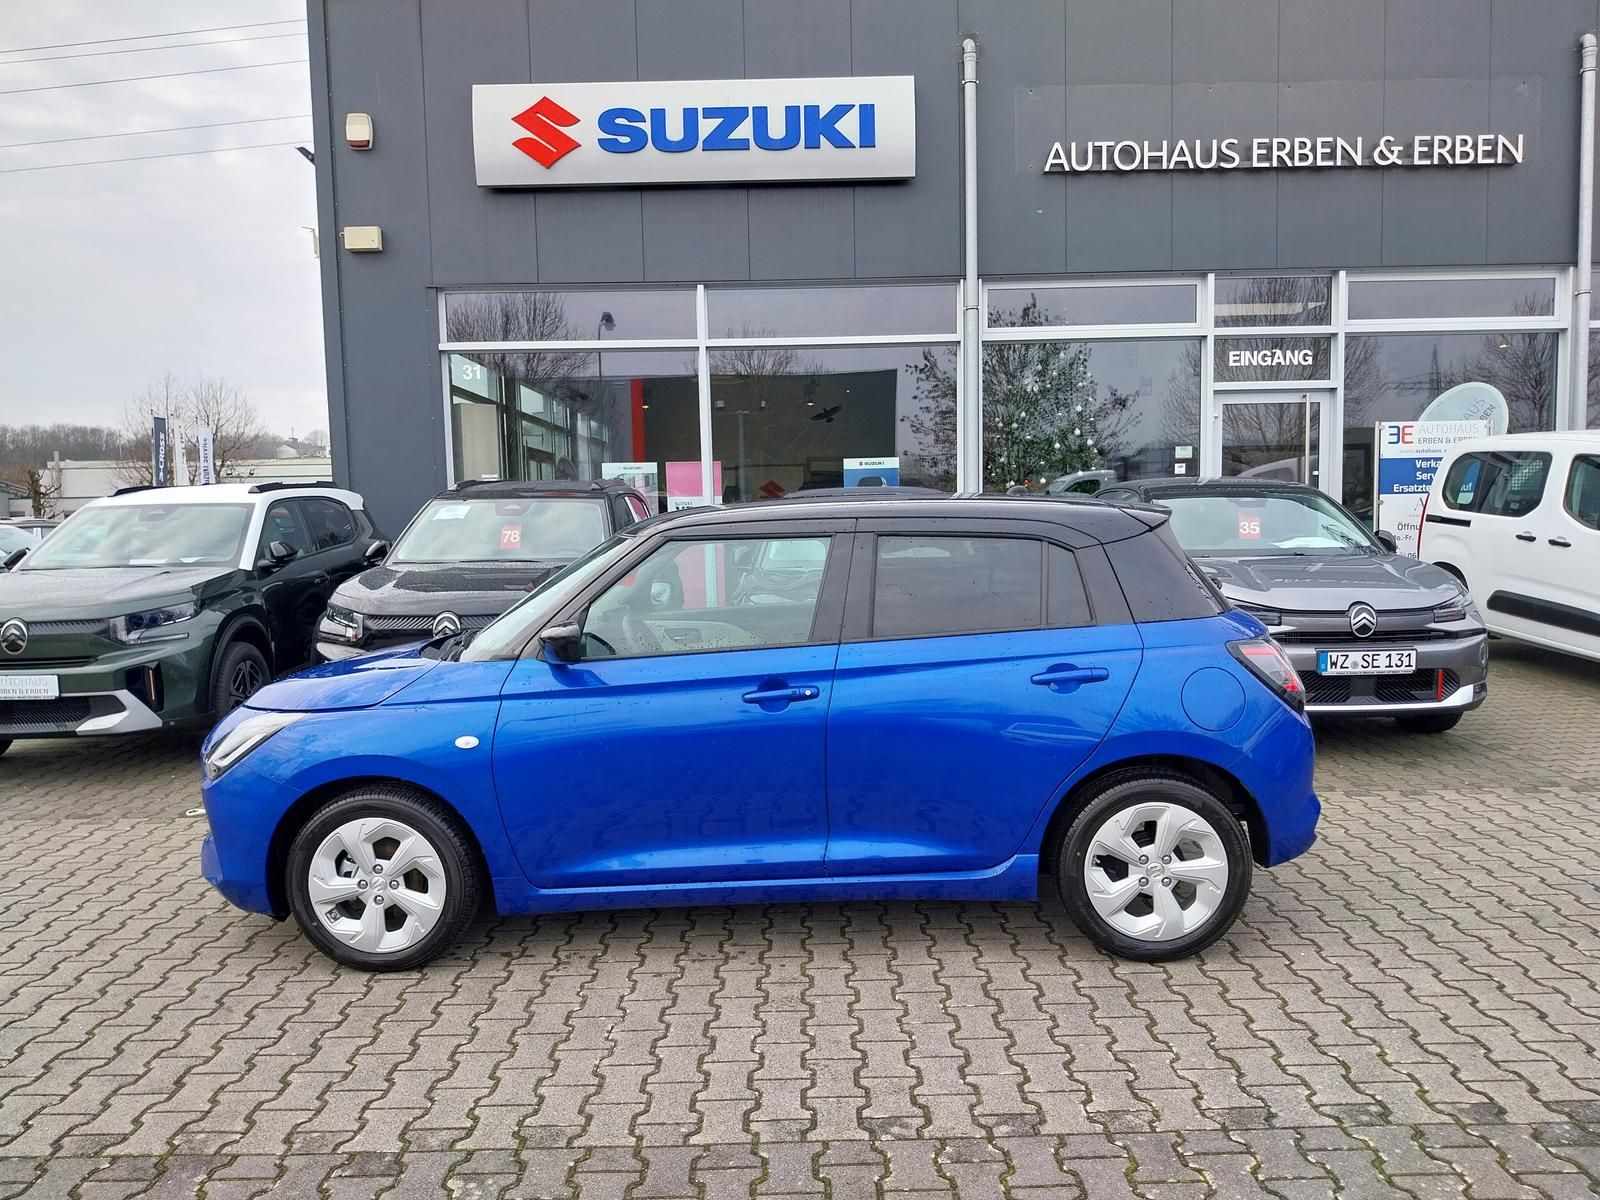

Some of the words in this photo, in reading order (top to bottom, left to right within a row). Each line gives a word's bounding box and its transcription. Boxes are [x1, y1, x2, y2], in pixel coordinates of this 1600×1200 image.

[597, 103, 876, 153] SUZUKI
[1044, 138, 1240, 172] AUTOHAUS
[1252, 136, 1362, 168] ERBEN
[1373, 135, 1403, 166] &
[1413, 134, 1524, 165] ERBEN
[1228, 350, 1313, 366] EINGANG
[463, 365, 481, 380] 31
[1419, 422, 1479, 434] AUTOHAUS
[1418, 437, 1444, 446] ERBEN
[1415, 460, 1441, 468] Verka
[1416, 472, 1436, 480] Serv
[1393, 483, 1431, 492] Ersatzte
[1240, 521, 1260, 534] 35
[1398, 521, 1420, 531] Öffnu
[502, 530, 520, 543] 78
[1329, 654, 1349, 669] WZ
[1361, 653, 1380, 669] SE
[1385, 653, 1413, 668] 131
[0, 678, 48, 687] UTOHAUS
